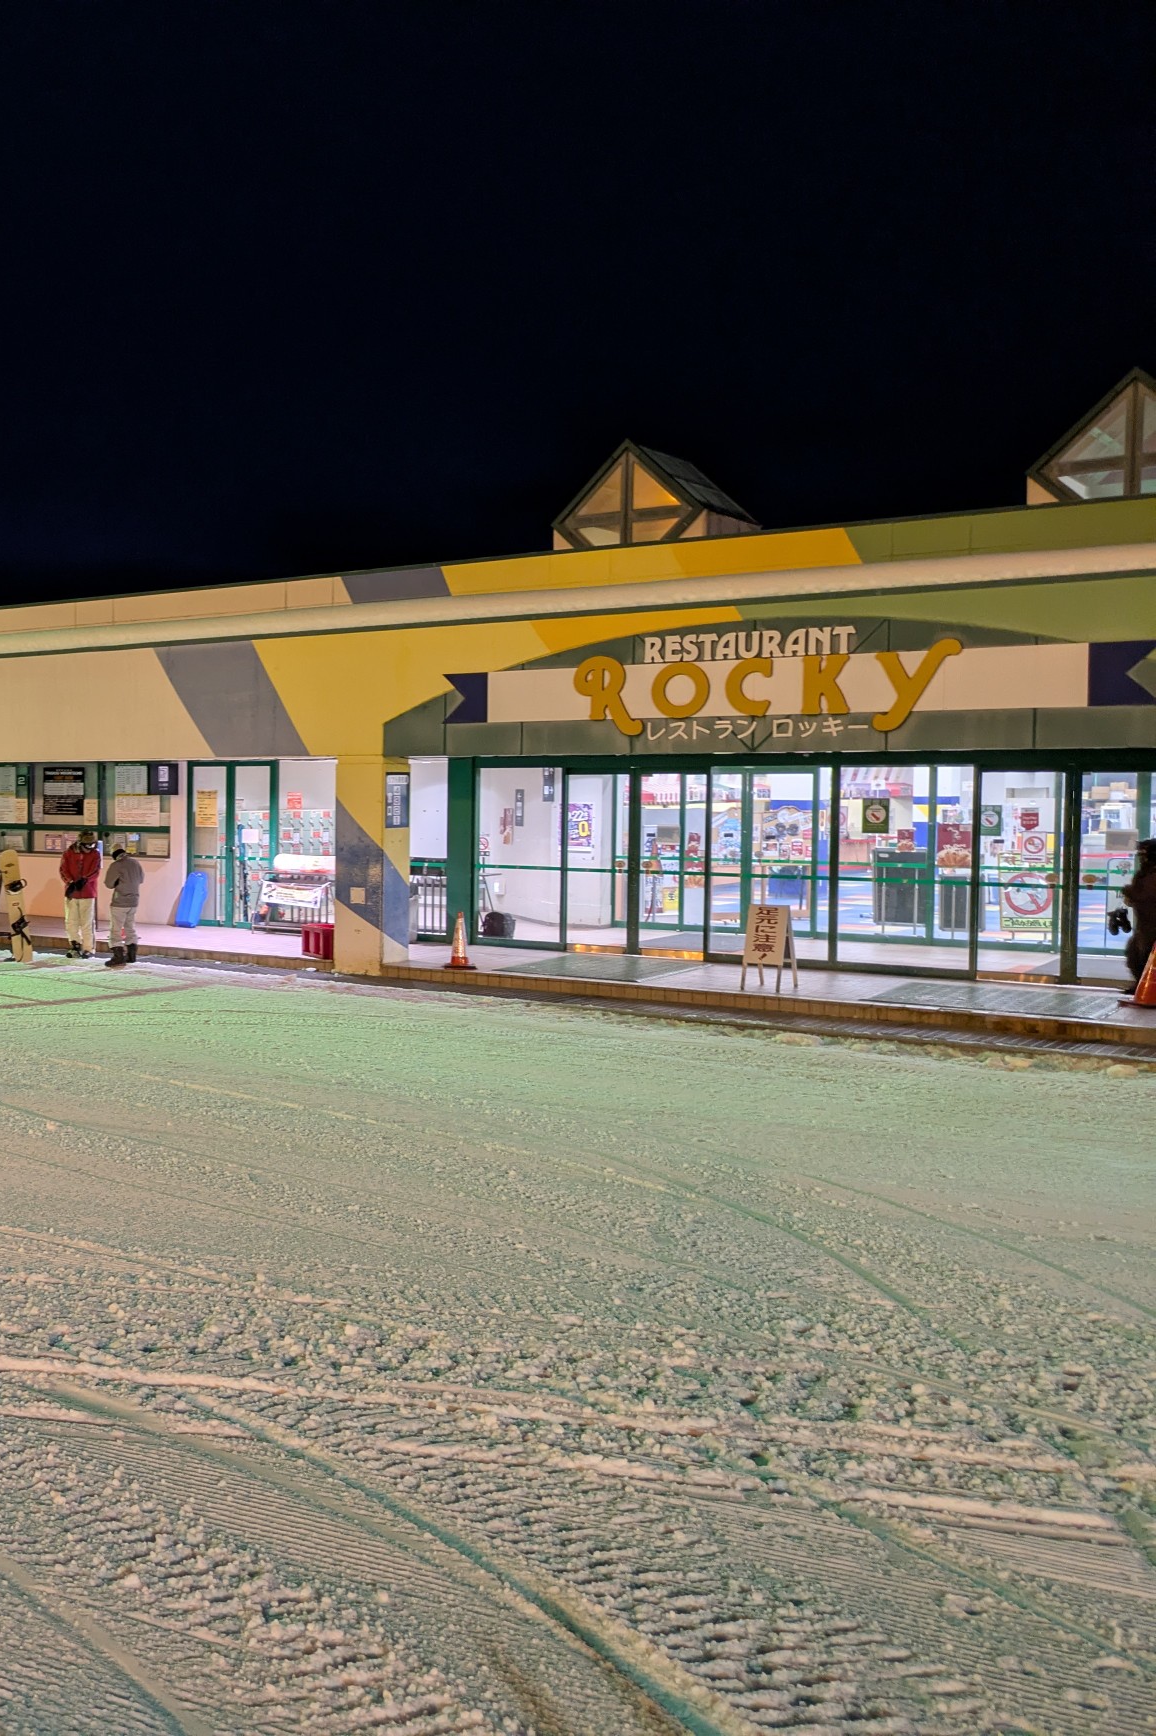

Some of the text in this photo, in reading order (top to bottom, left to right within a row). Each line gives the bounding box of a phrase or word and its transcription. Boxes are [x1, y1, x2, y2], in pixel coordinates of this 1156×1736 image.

[644, 624, 857, 663] RESTAURANT
[573, 638, 963, 736] ROCKY
[646, 716, 869, 741] レストラン ロッキー
[752, 906, 779, 961] 足元に注意！
